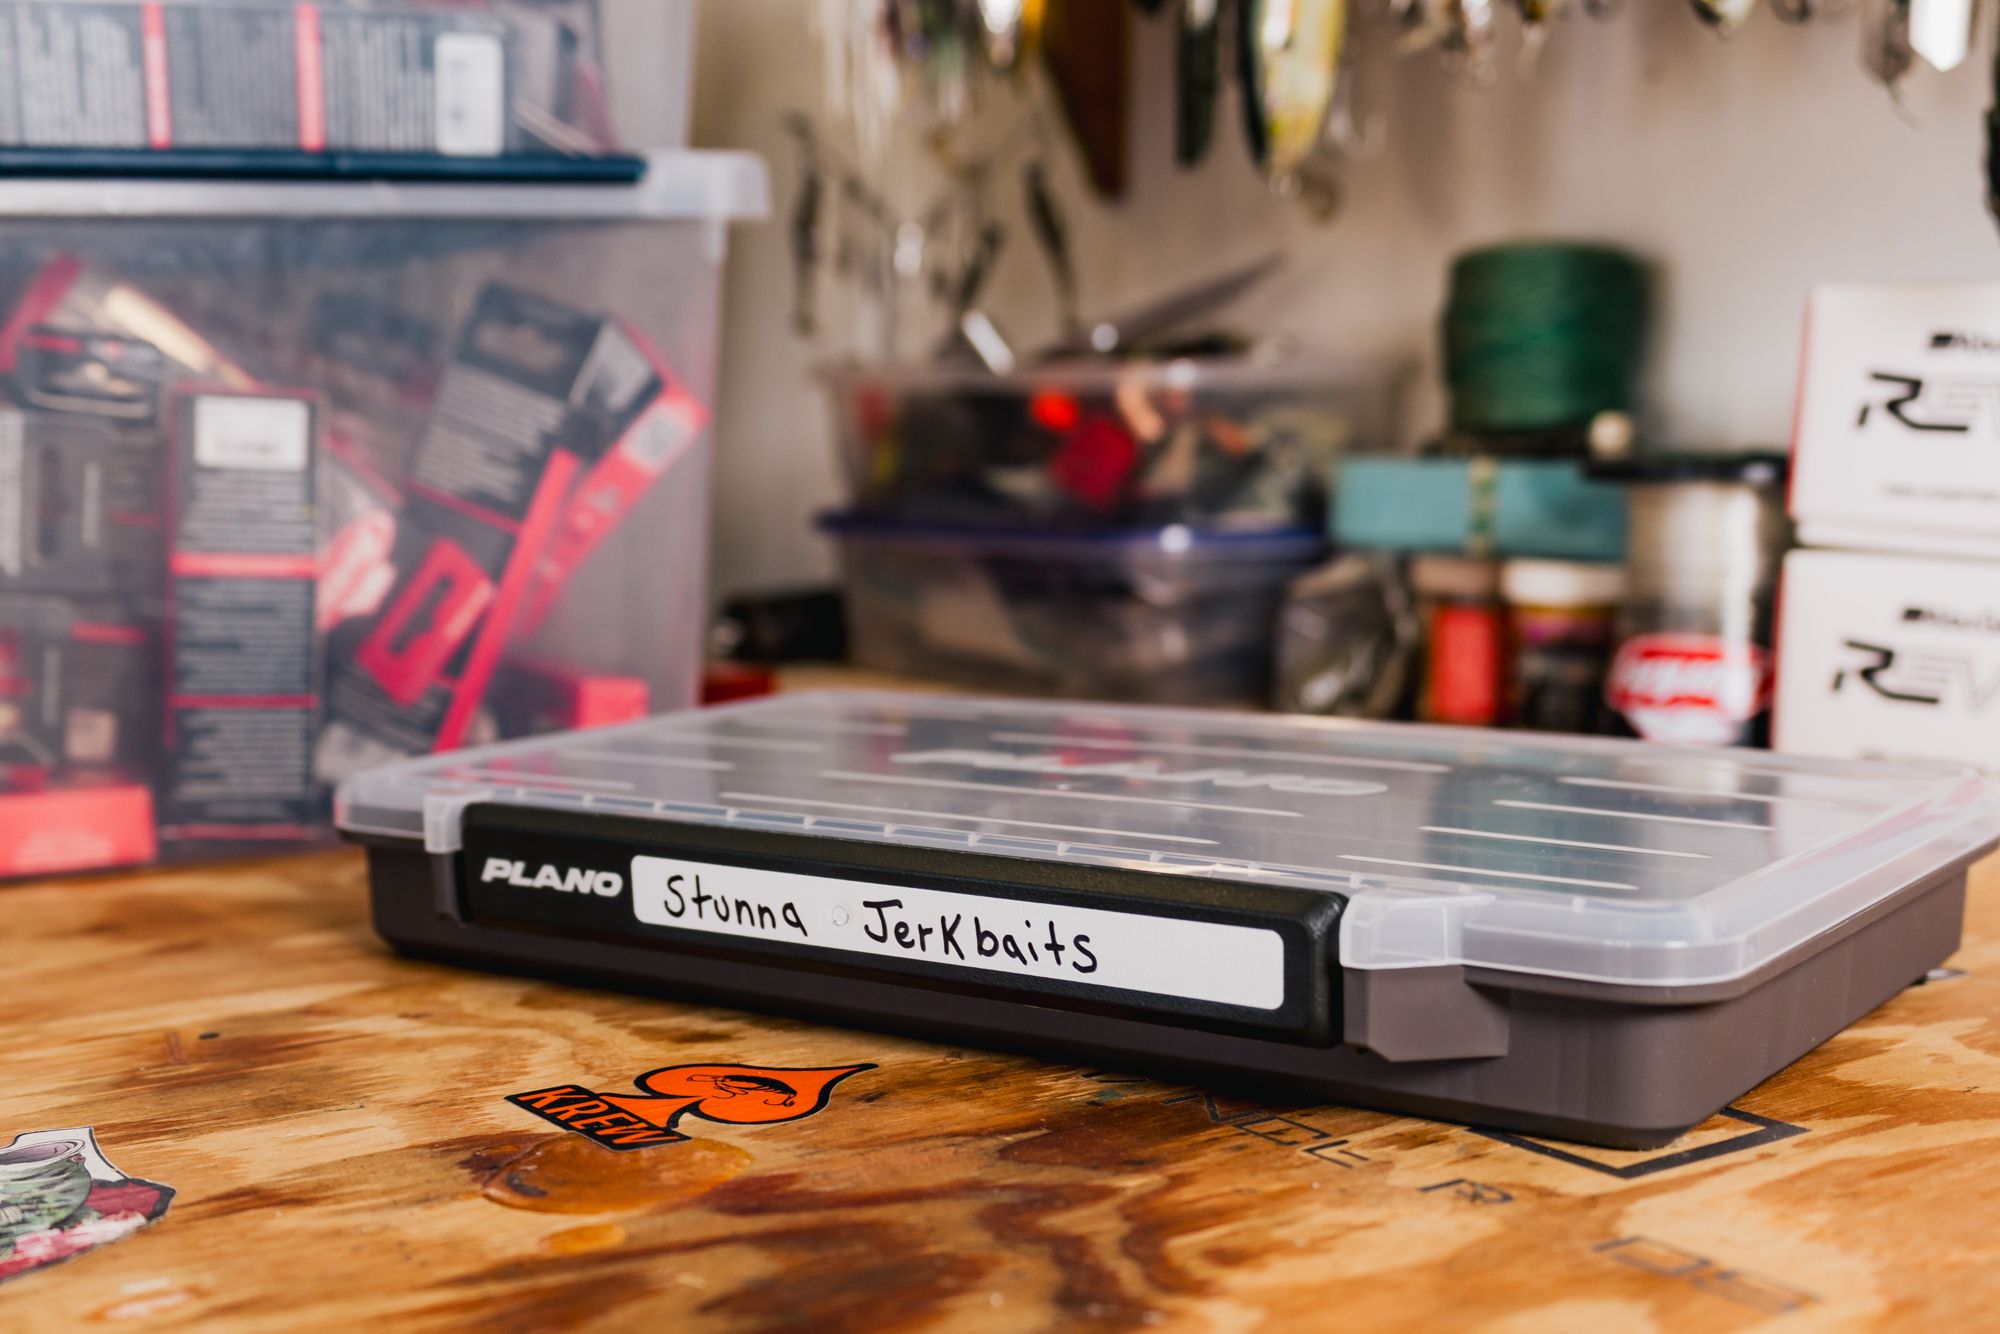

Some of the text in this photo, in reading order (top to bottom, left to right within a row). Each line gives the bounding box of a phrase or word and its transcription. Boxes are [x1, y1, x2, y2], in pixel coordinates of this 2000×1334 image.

[481, 857, 623, 899] PLANO
[662, 873, 808, 938] Stunna
[516, 1086, 683, 1144] KREW
